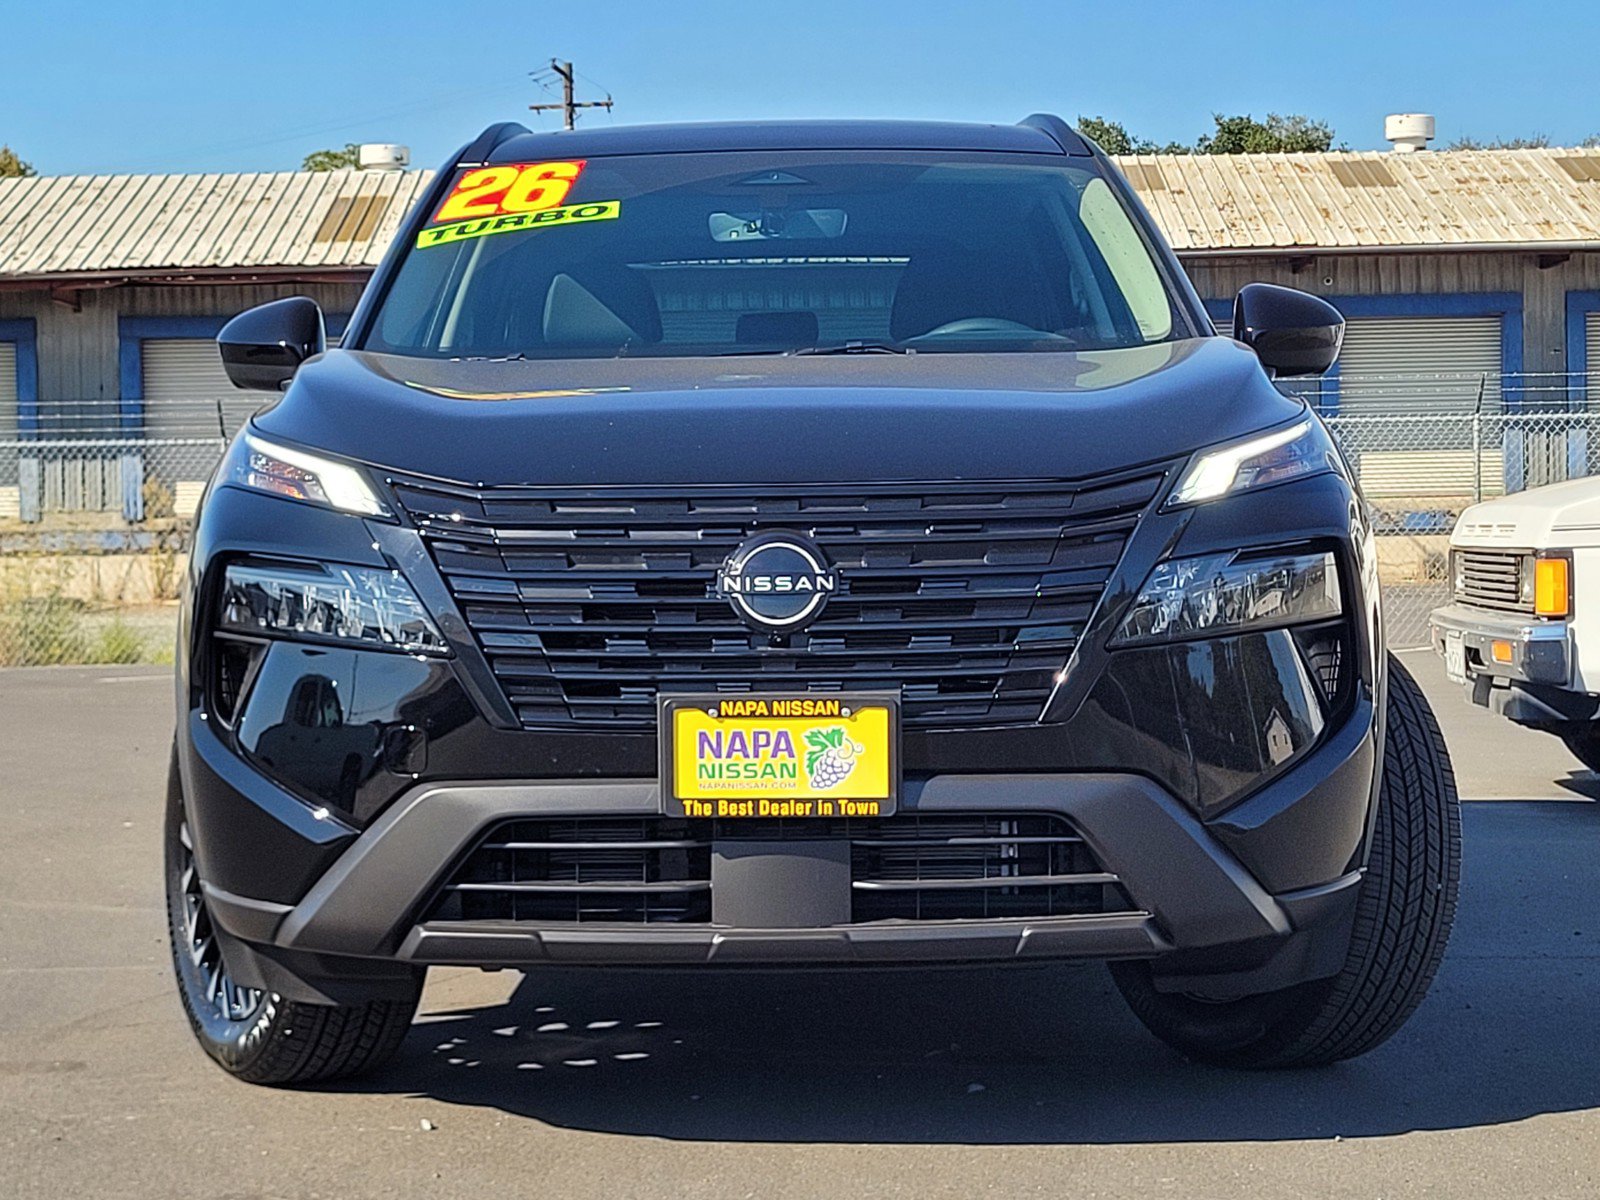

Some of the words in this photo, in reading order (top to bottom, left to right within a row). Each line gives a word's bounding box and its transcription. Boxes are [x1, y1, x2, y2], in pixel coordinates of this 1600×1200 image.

[437, 162, 579, 221] 26
[429, 205, 608, 241] TURBO
[723, 575, 834, 592] NISSAN
[720, 700, 768, 716] NAPA
[772, 700, 840, 716] NISSAN
[698, 731, 796, 759] NAPA
[699, 762, 797, 779] NISSAN
[699, 781, 797, 790] NAPANISSAN.COM
[683, 800, 713, 816] The
[718, 800, 754, 816] Best
[759, 800, 812, 816] Dealer
[840, 800, 879, 816] Town
